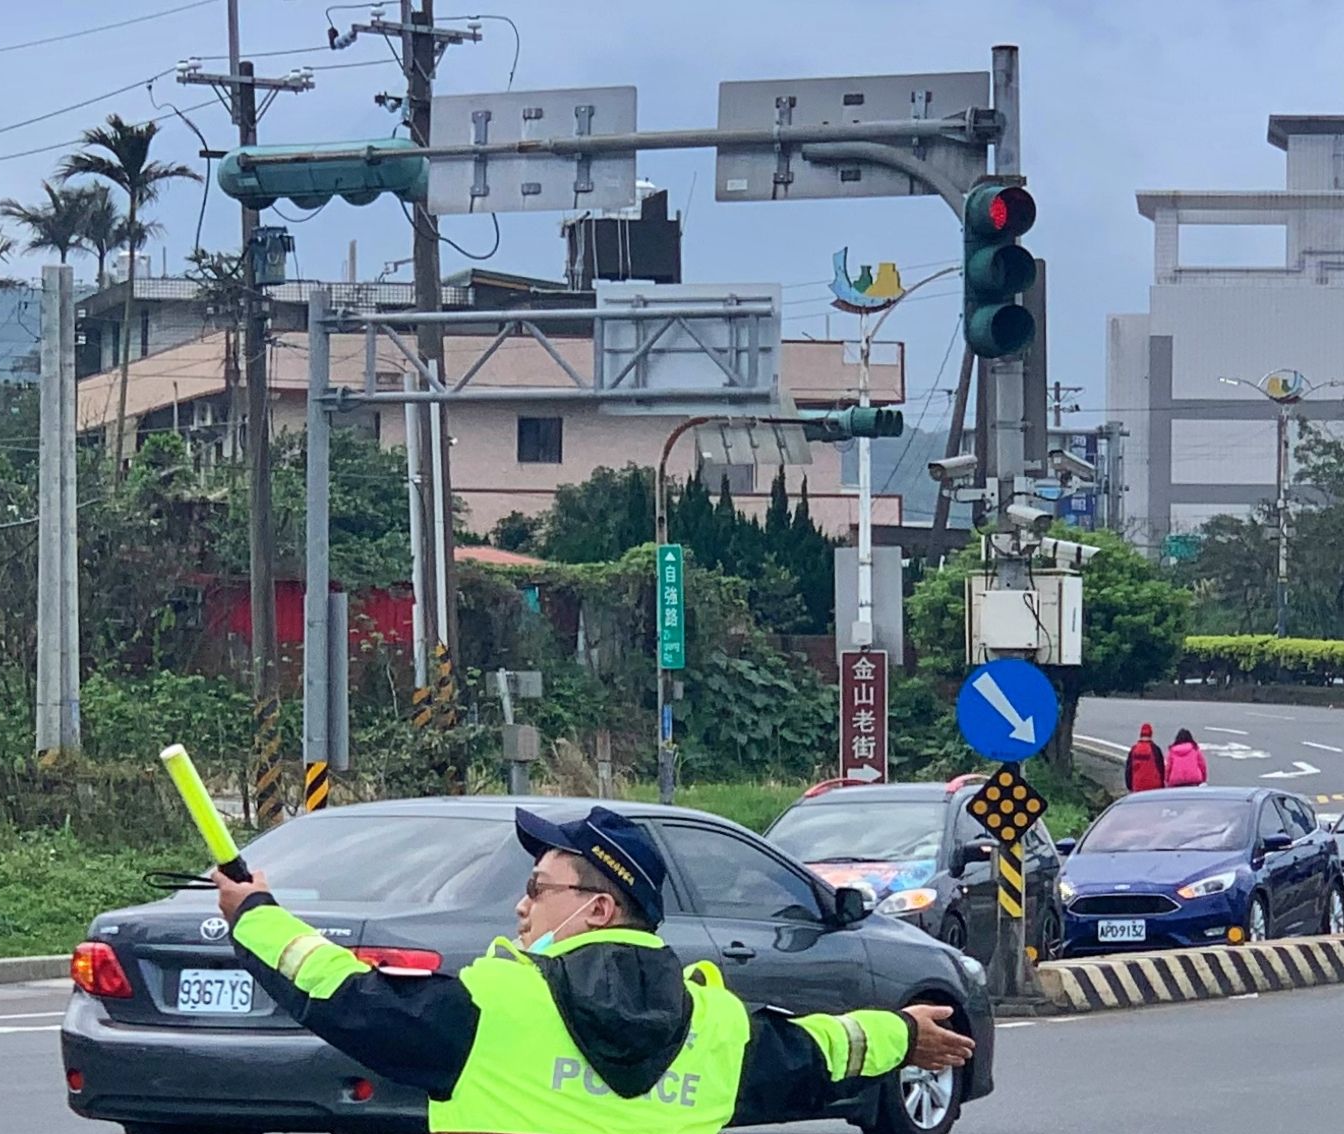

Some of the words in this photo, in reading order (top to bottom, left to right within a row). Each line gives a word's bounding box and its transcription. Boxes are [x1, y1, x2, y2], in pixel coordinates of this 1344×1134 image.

[664, 565, 678, 627] 自強路
[851, 656, 876, 760] 金山老街
[552, 1057, 701, 1107] POCE
